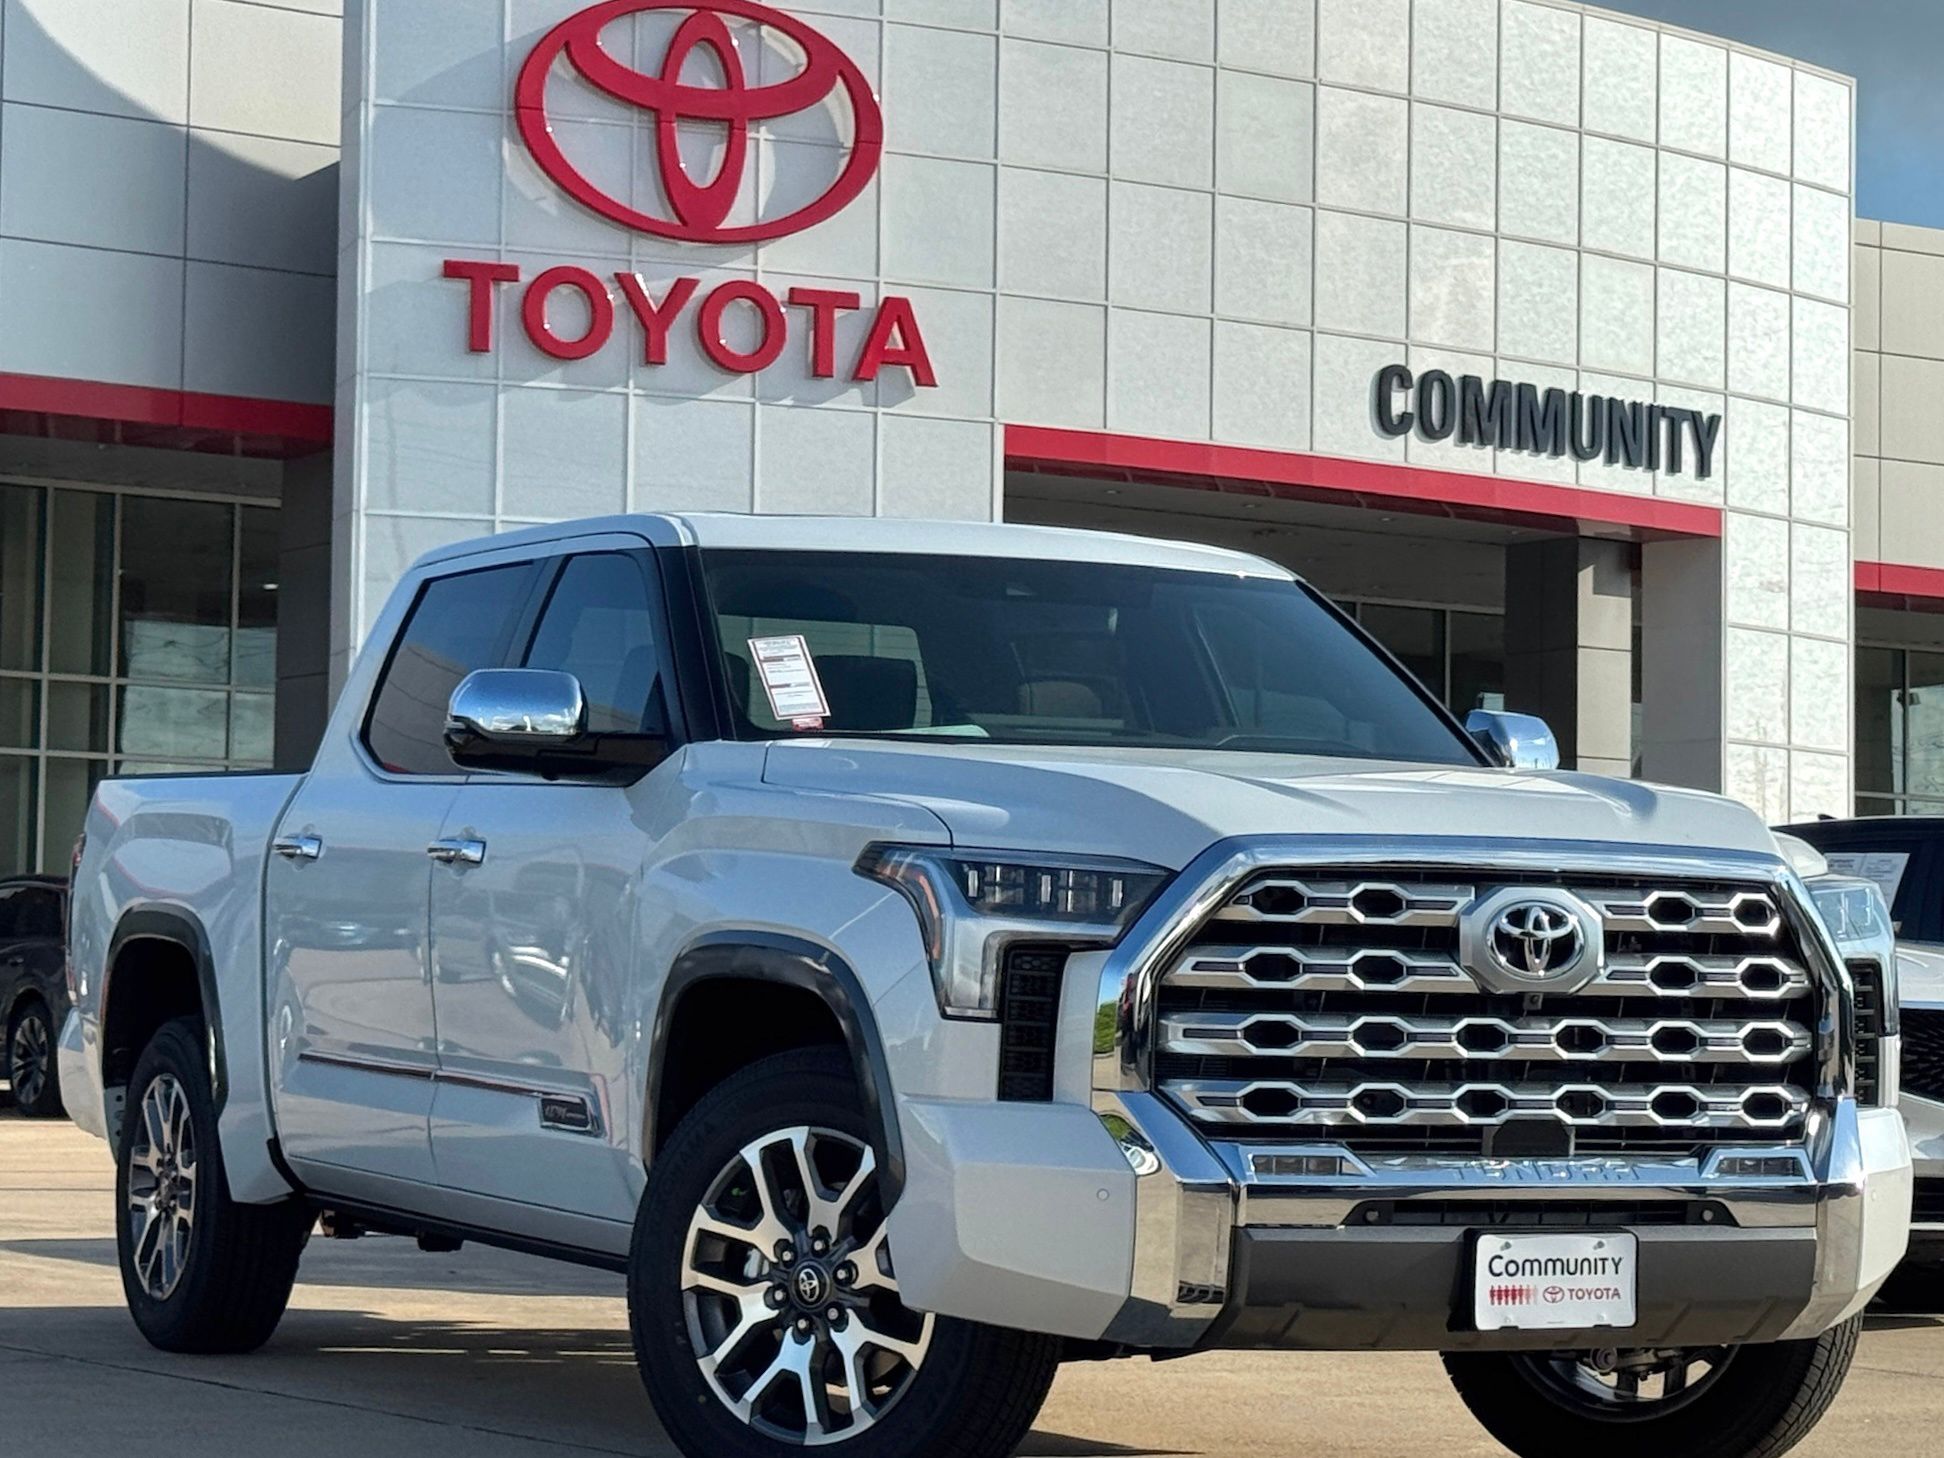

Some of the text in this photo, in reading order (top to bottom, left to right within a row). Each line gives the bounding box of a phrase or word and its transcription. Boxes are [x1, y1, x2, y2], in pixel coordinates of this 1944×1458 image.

[442, 259, 939, 388] TOYOTA
[1372, 363, 1722, 480] COMMUNITY
[1567, 1287, 1621, 1301] TOYOTA
